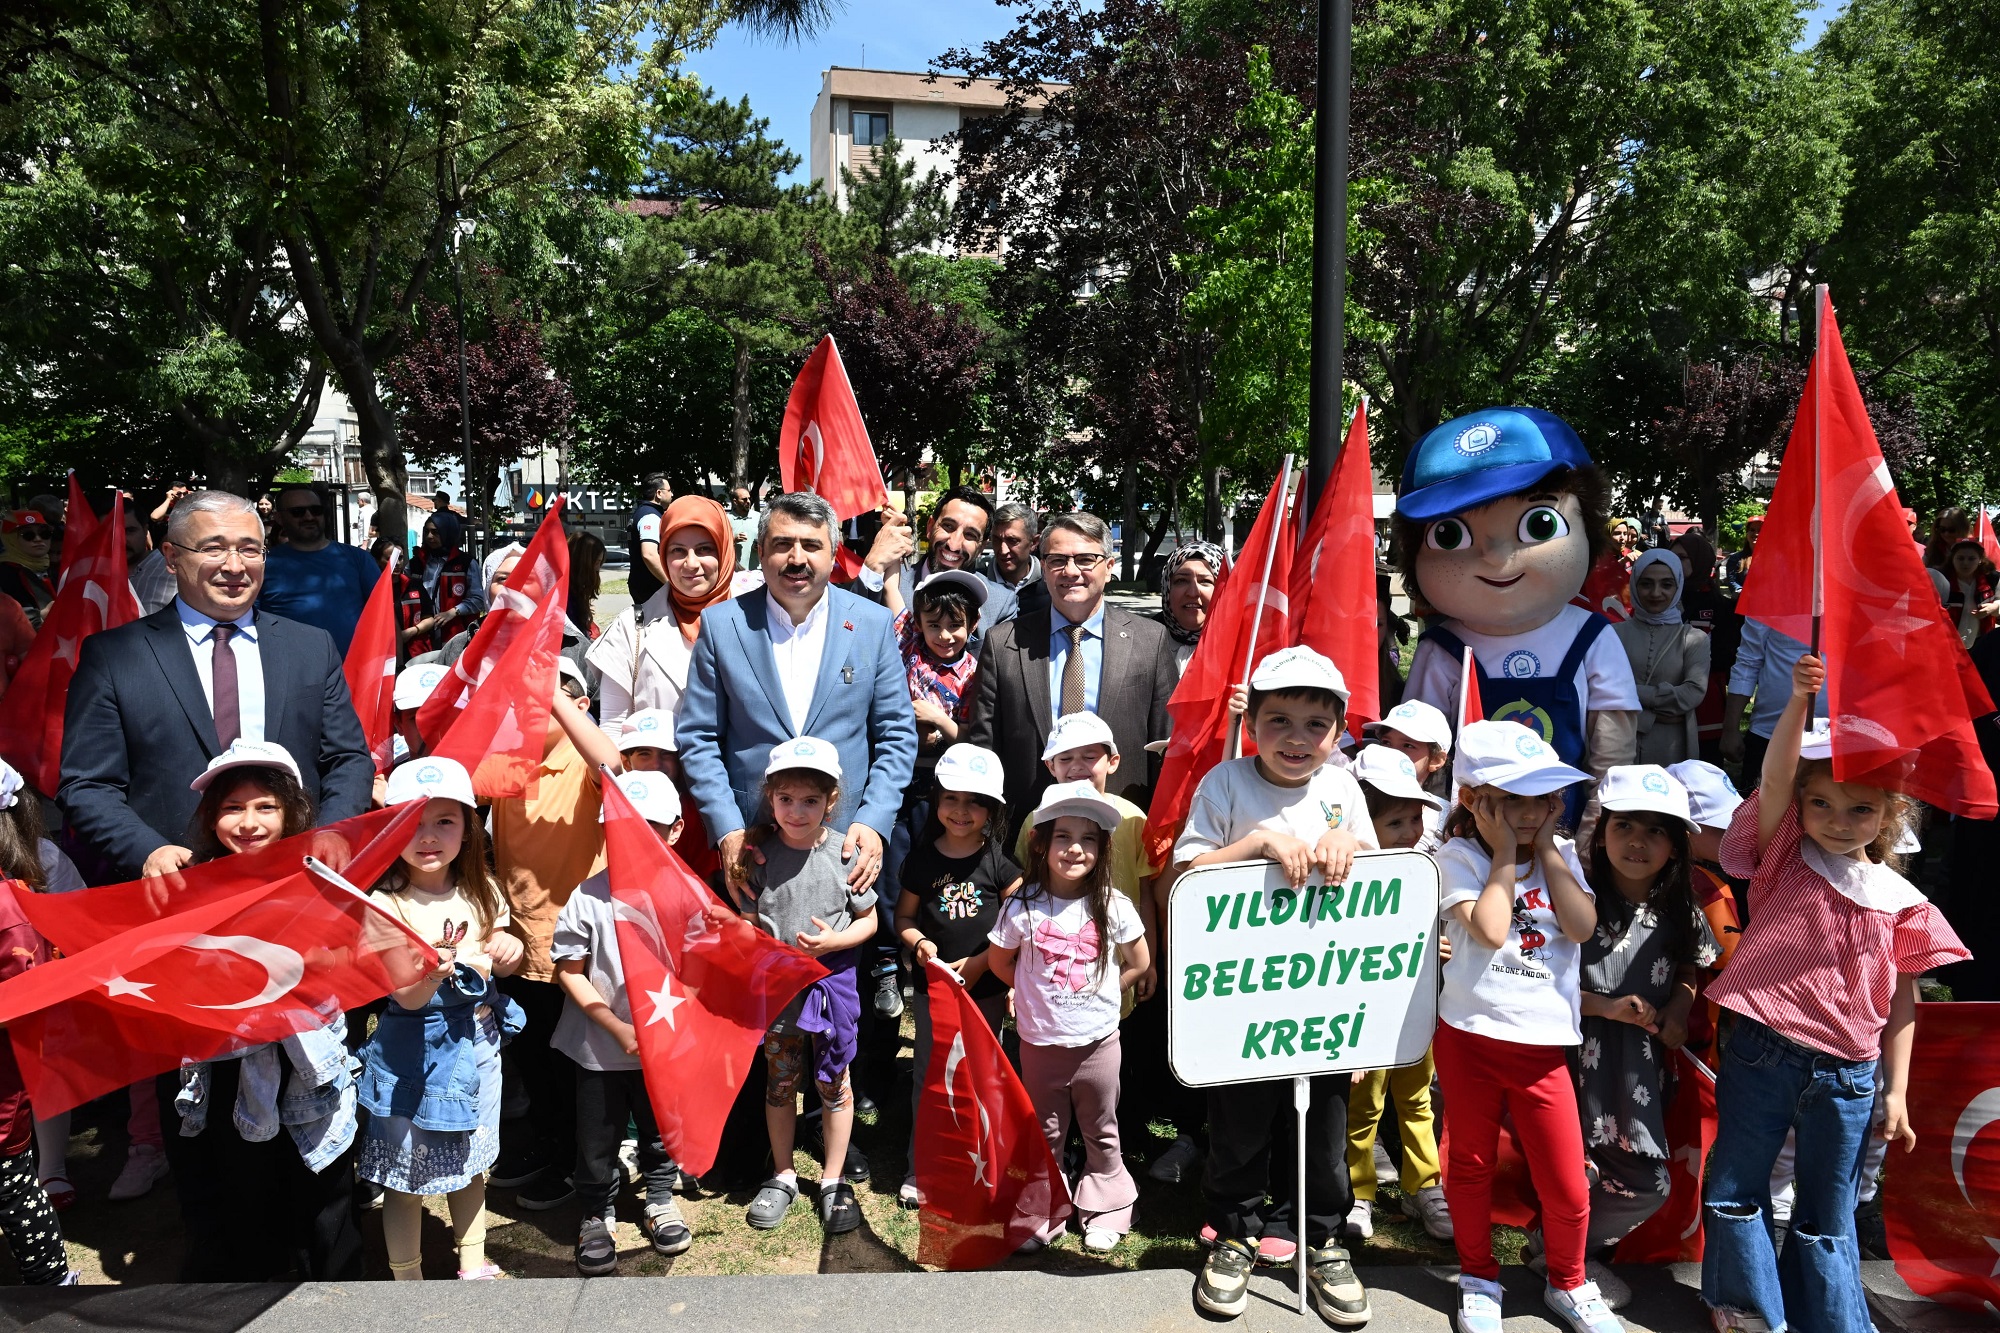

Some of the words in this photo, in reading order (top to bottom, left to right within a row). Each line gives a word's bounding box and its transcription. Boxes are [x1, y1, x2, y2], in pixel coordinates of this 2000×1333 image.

[932, 872, 955, 888] Hello
[1206, 878, 1402, 932] YILDIRIM
[1183, 932, 1425, 1001] BELEDİYESİ
[1491, 964, 1505, 973] THE
[1505, 966, 1520, 975] ONE
[1520, 969, 1535, 978] AND
[1241, 1002, 1366, 1060] KREŞİ
